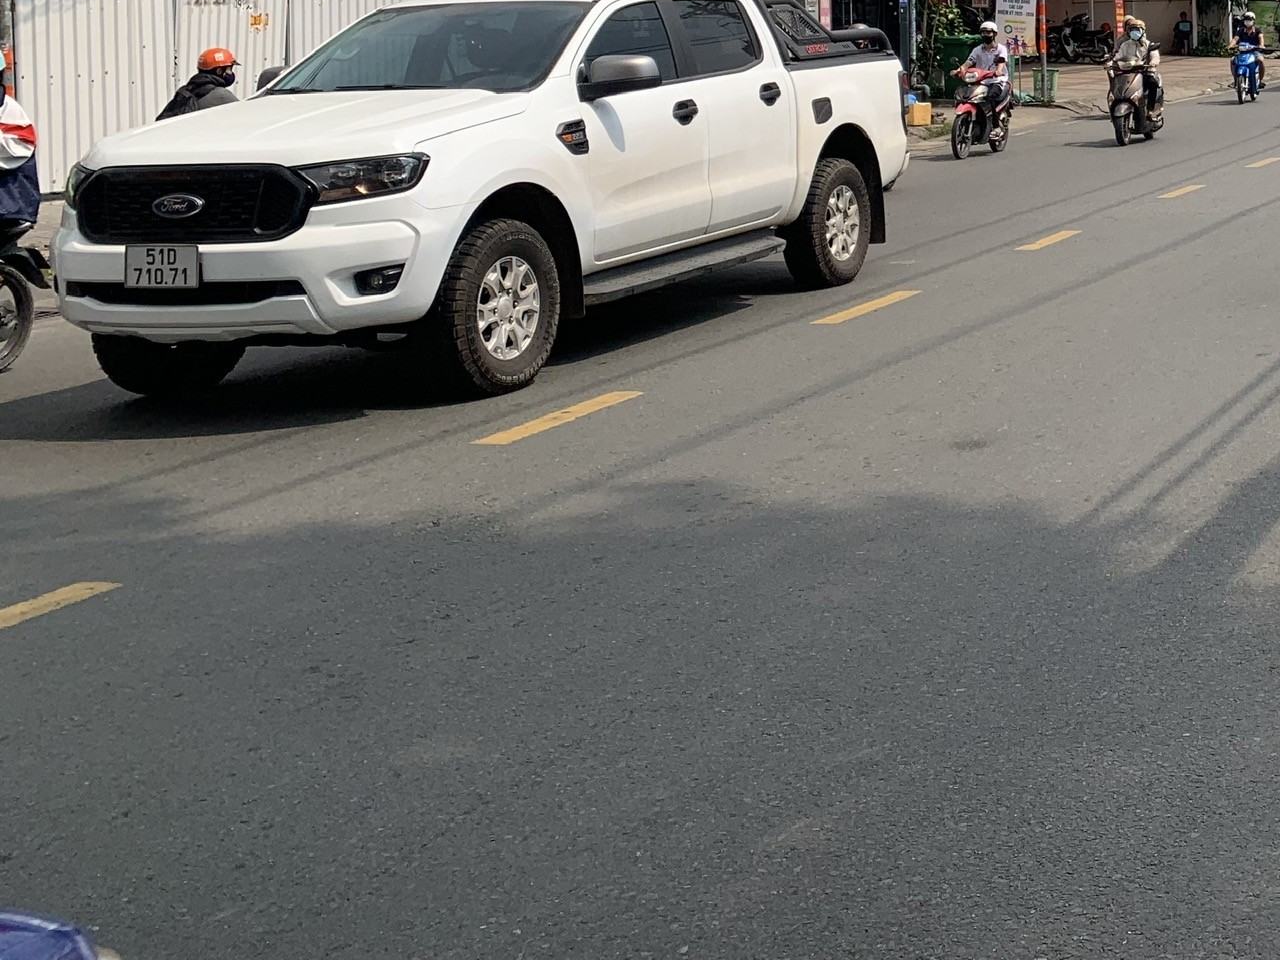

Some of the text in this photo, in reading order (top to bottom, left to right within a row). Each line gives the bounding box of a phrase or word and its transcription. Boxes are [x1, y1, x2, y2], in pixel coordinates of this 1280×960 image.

[161, 198, 189, 212] Ford
[145, 248, 177, 266] 51D
[133, 267, 188, 286] 710.71
